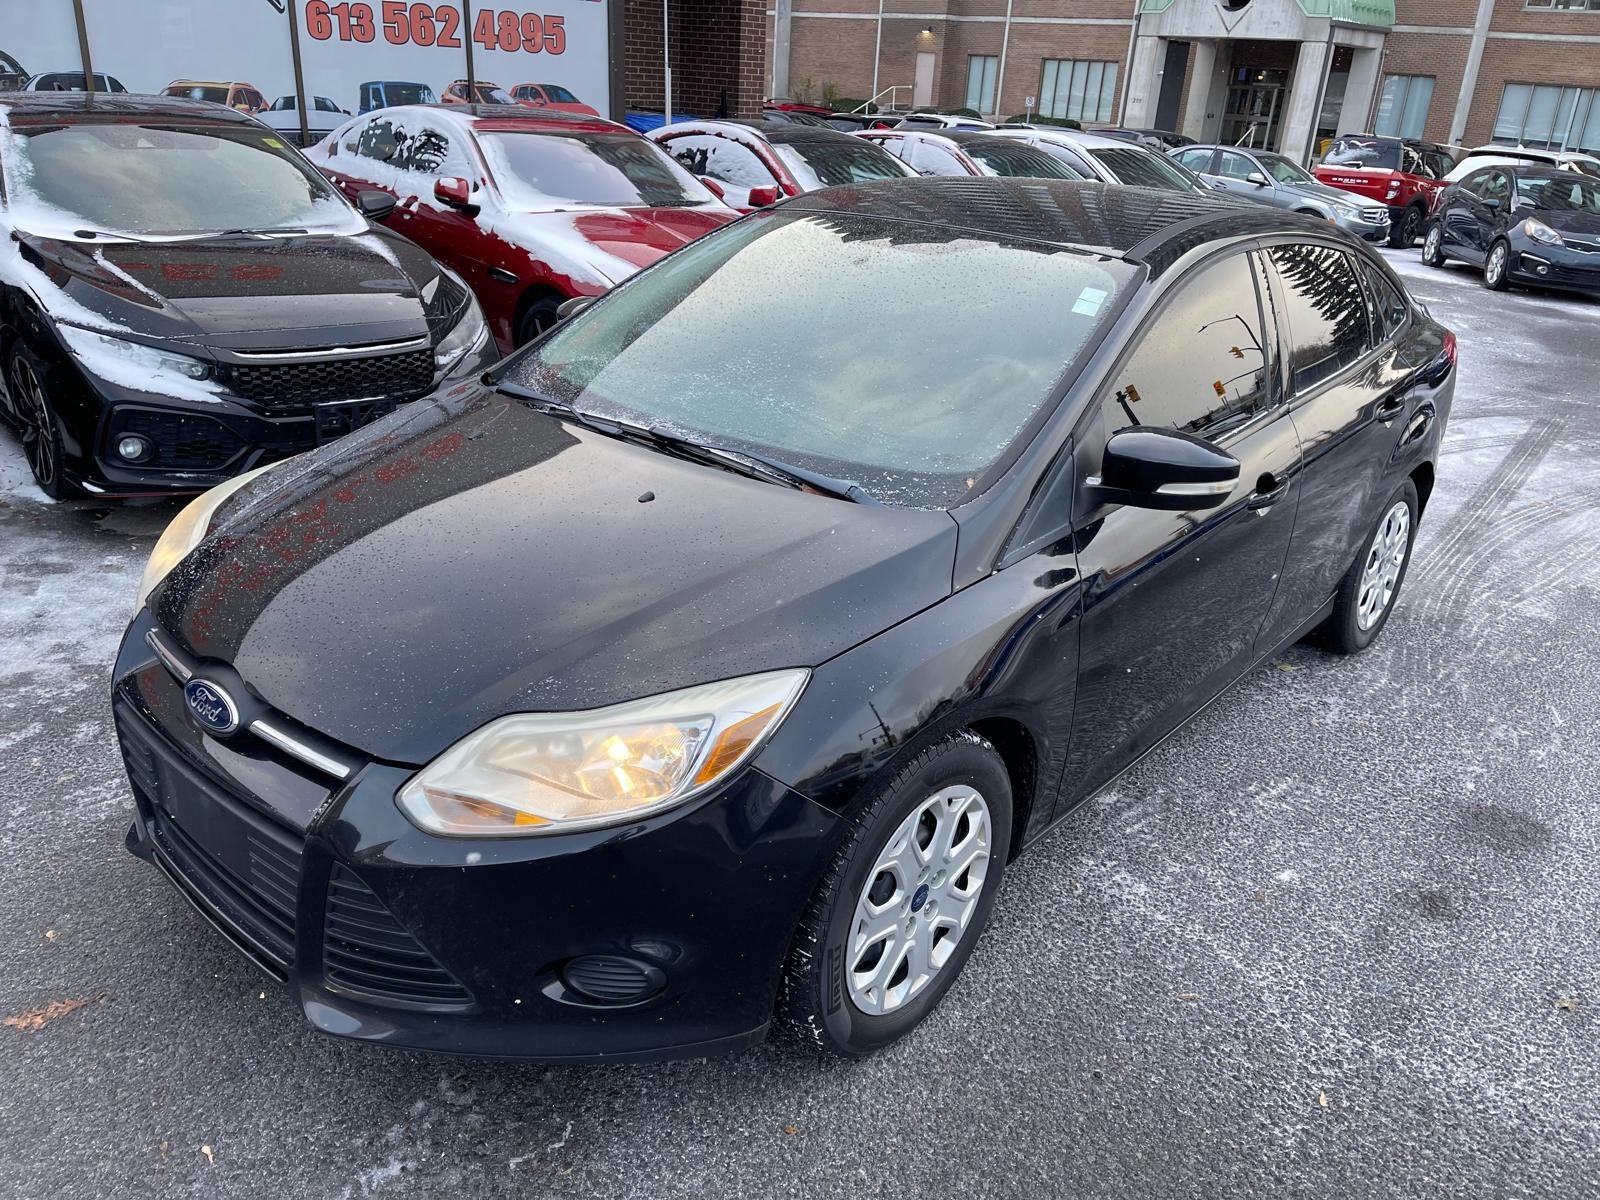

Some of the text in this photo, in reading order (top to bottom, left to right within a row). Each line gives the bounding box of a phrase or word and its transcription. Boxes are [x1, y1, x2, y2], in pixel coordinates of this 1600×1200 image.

[306, 0, 566, 55] 613 562 4895
[190, 687, 222, 722] Ford
[826, 943, 842, 1016] PIRELLI
